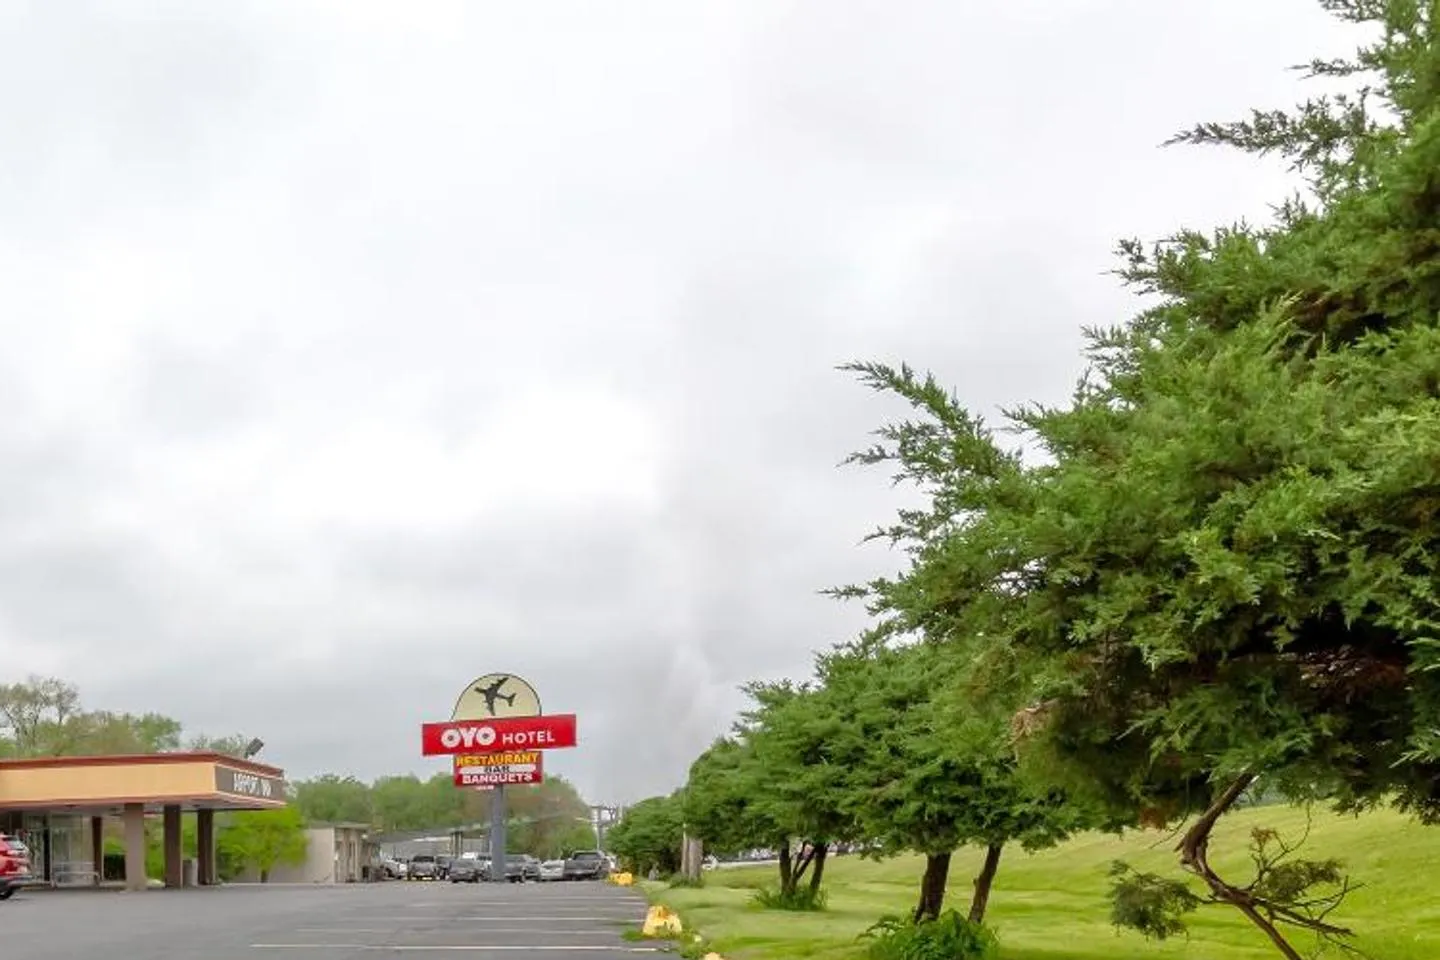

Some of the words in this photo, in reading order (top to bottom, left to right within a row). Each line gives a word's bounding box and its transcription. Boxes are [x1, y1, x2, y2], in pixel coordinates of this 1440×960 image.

[441, 727, 496, 748] OYO
[502, 731, 556, 745] HOTEL
[456, 752, 538, 767] RESTAURANT
[462, 773, 534, 784] BANQUETS
